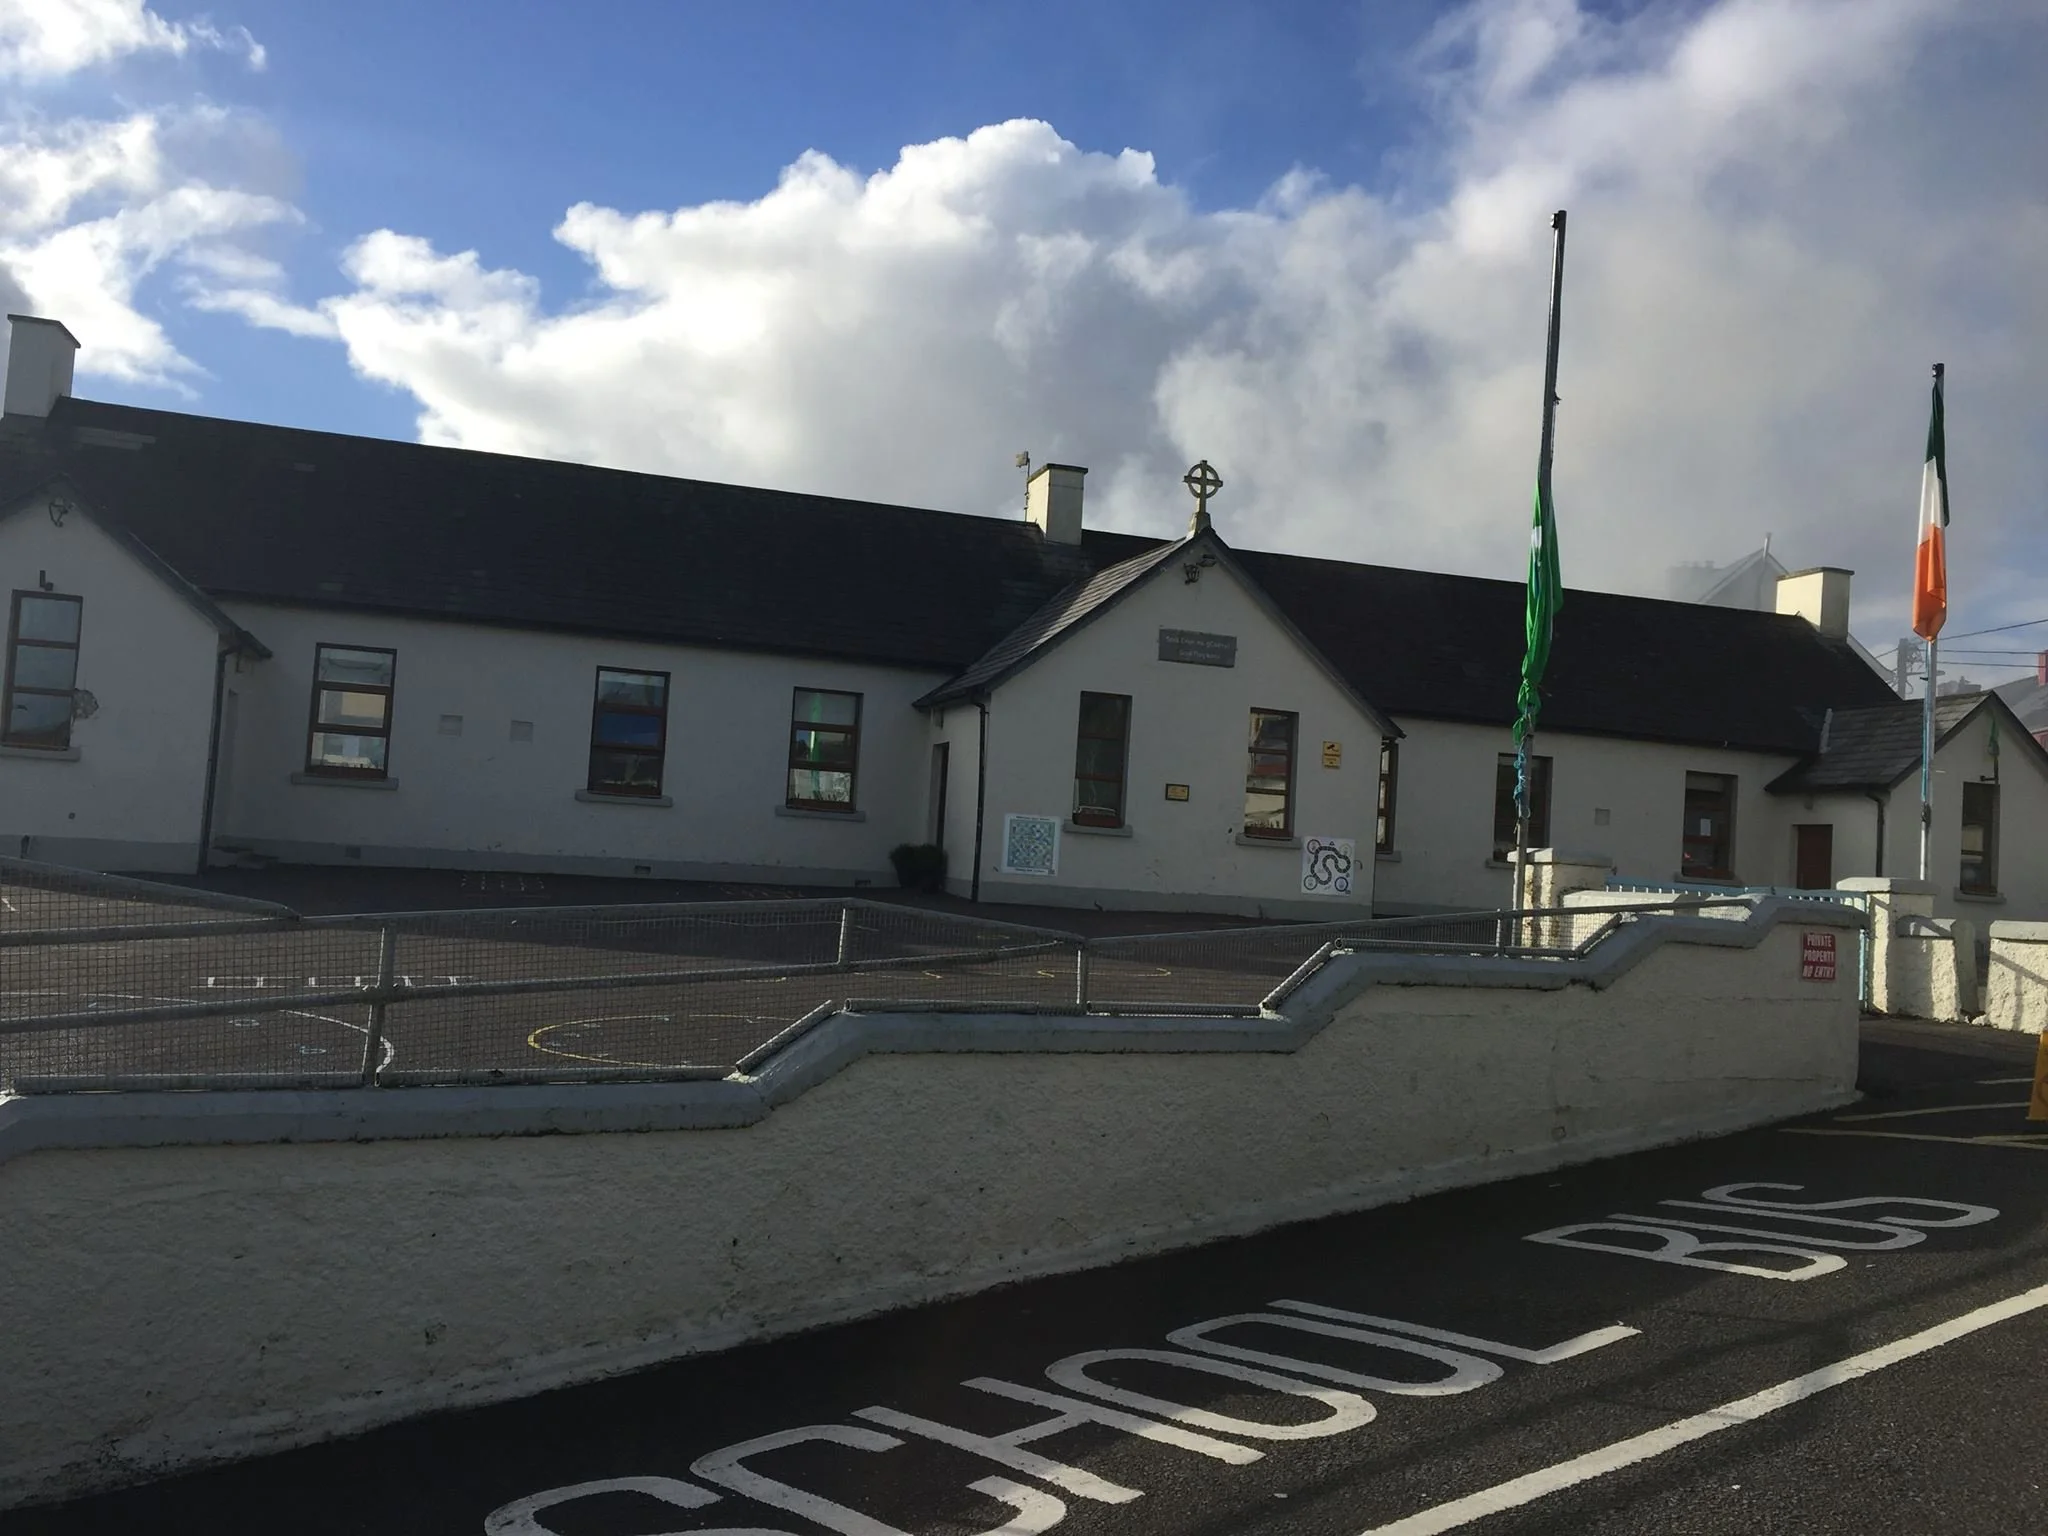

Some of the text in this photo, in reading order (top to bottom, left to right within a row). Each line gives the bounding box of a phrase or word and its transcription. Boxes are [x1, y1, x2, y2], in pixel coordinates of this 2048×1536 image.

[1807, 934, 1832, 947] PRIVATE
[1804, 949, 1834, 962] PROPERTY
[1803, 965, 1835, 978] NO ENTRY
[1521, 1182, 2001, 1282] BUS
